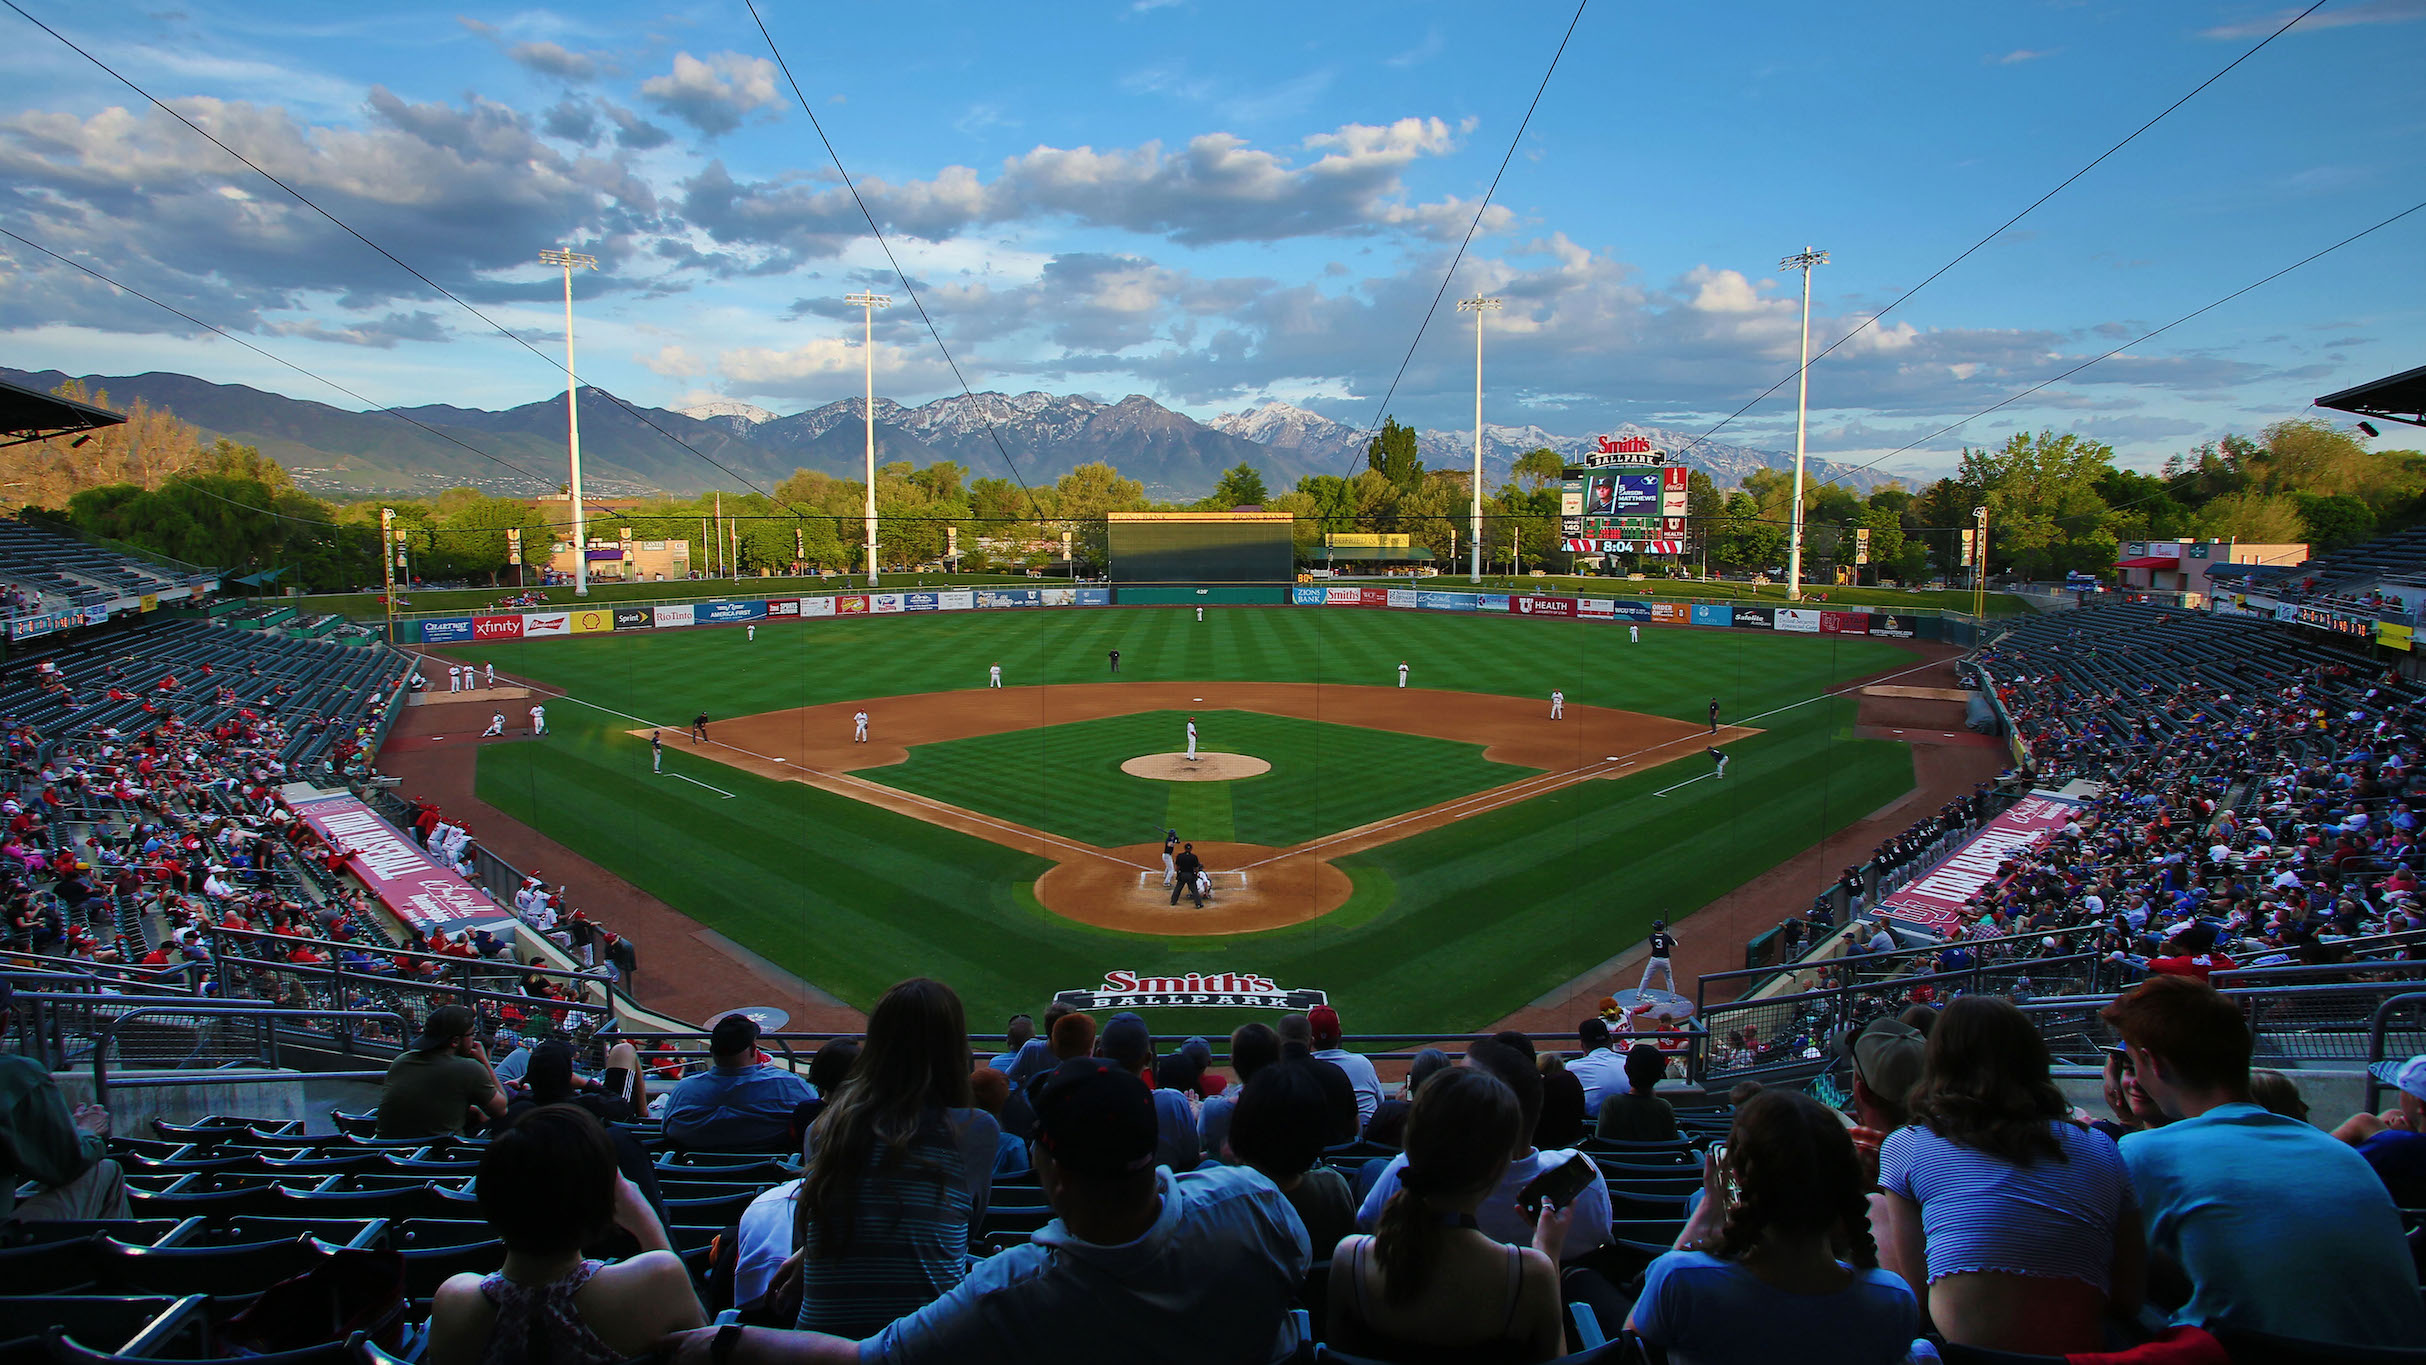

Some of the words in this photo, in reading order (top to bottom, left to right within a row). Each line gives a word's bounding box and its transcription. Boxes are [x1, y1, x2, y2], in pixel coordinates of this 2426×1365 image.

[1598, 436, 1650, 454] Smith's
[1595, 455, 1654, 465] BALLPARK
[1603, 541, 1634, 552] 8:04
[1298, 574, 1314, 582] 8:04
[1328, 589, 1359, 599] Smith's
[1535, 601, 1567, 610] HEALTH
[618, 613, 639, 623] Sprint
[425, 622, 470, 630] CHARTWAY
[476, 620, 520, 636] xfinity
[531, 619, 562, 629] Budweiser
[318, 811, 390, 837] UTAH
[339, 830, 433, 881] BASEBALL
[1946, 827, 2042, 874] BASEBALL
[1910, 867, 1996, 903] UTAH
[1655, 939, 1663, 948] 3
[1102, 971, 1275, 992] Smith's
[1092, 995, 1288, 1007] BALLPARK
